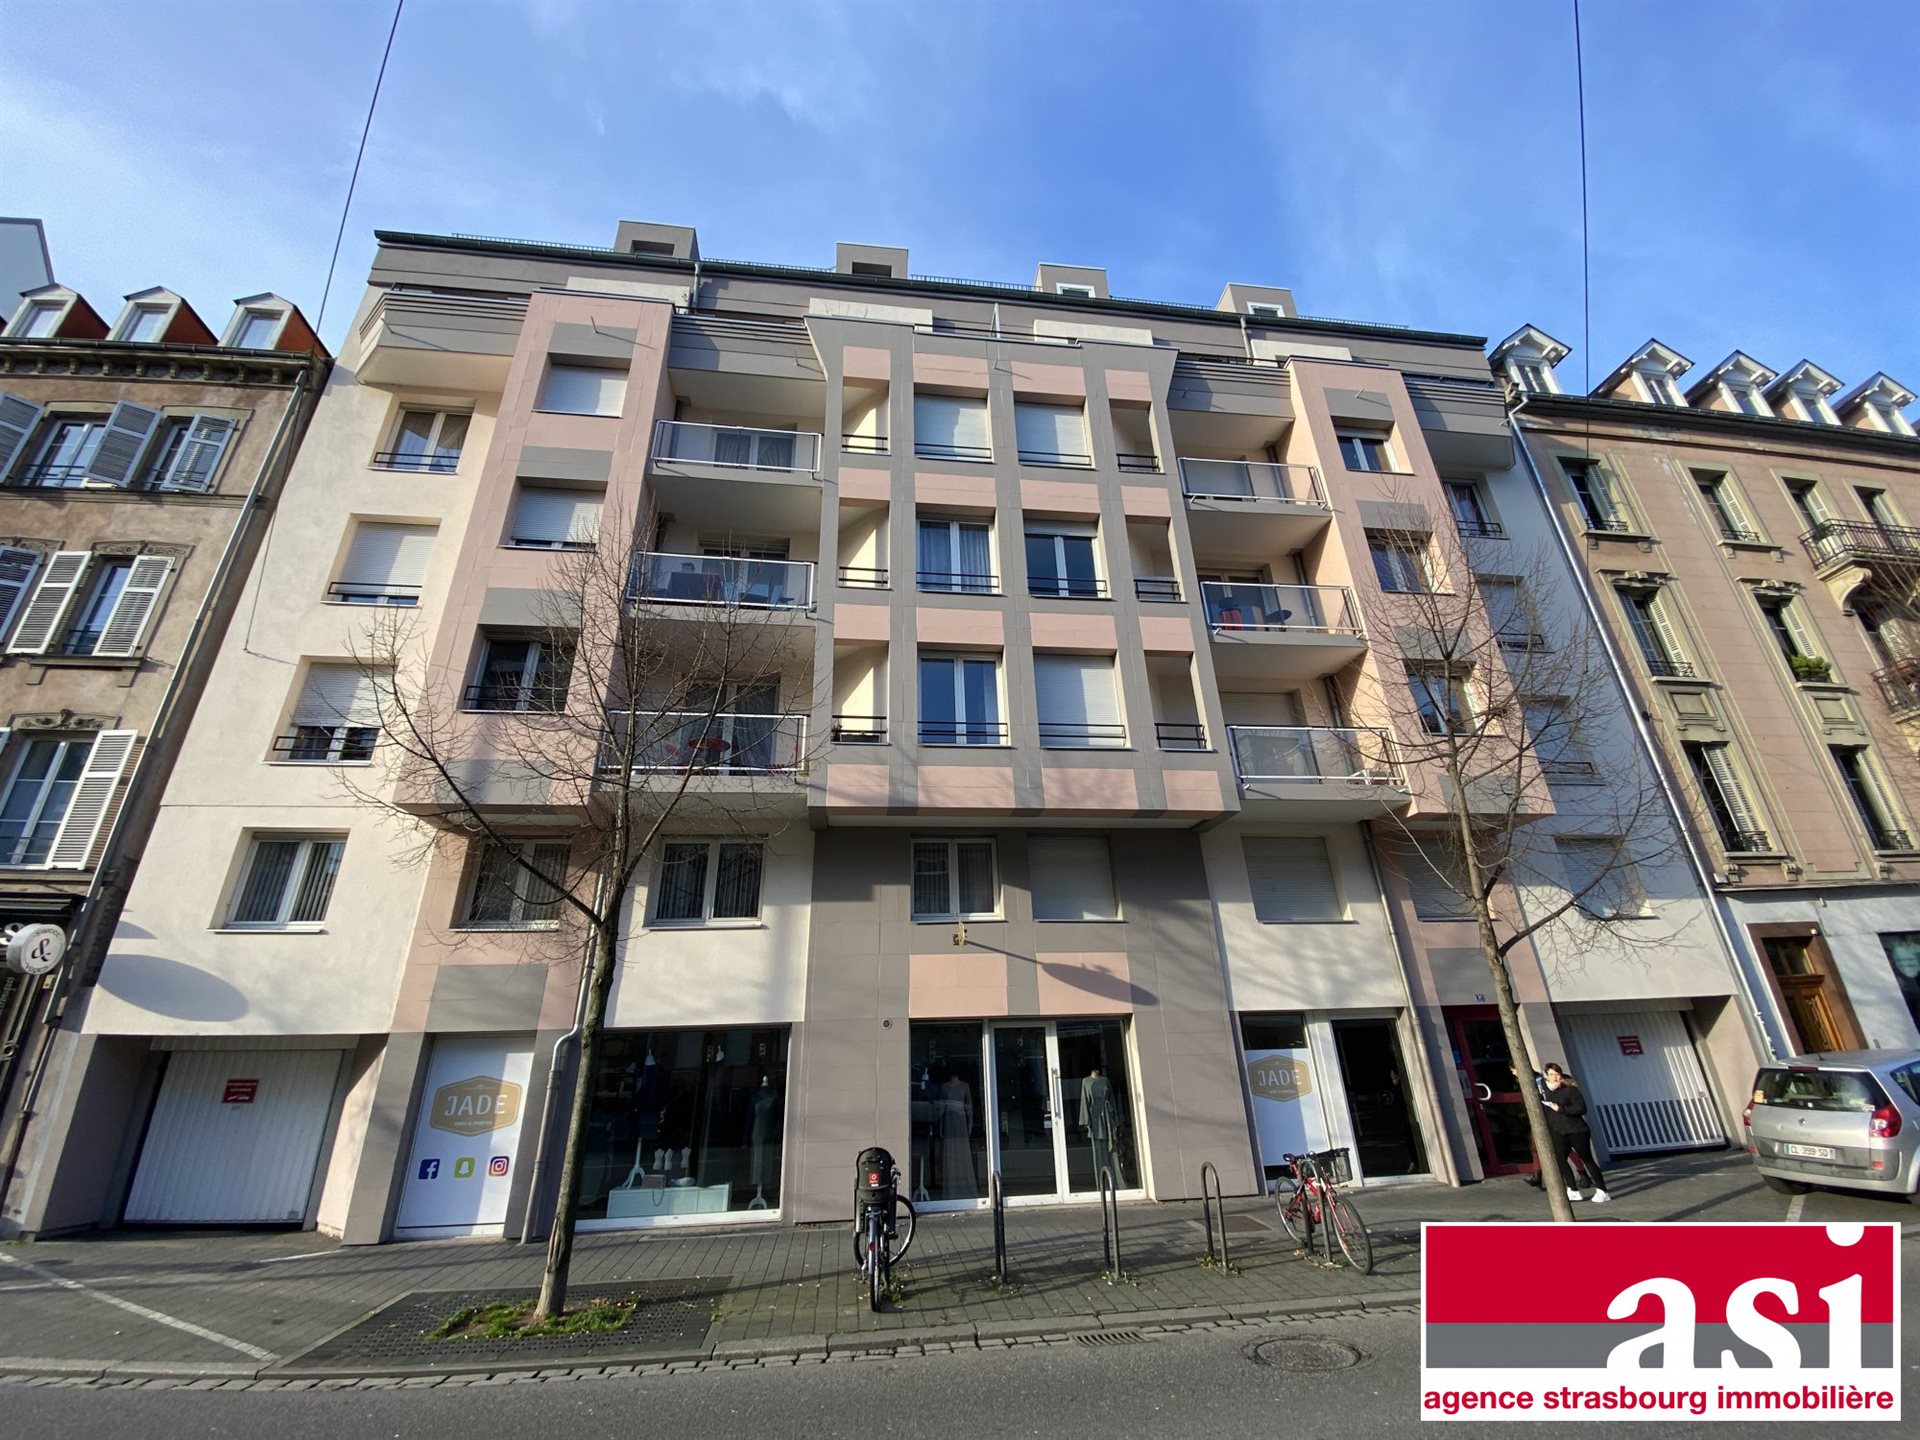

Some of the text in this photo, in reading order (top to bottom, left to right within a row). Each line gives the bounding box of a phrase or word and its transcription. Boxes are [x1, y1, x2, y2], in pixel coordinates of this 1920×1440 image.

[31, 938, 52, 962] &
[1257, 1069, 1302, 1087] JADE
[444, 1094, 508, 1117] JADE
